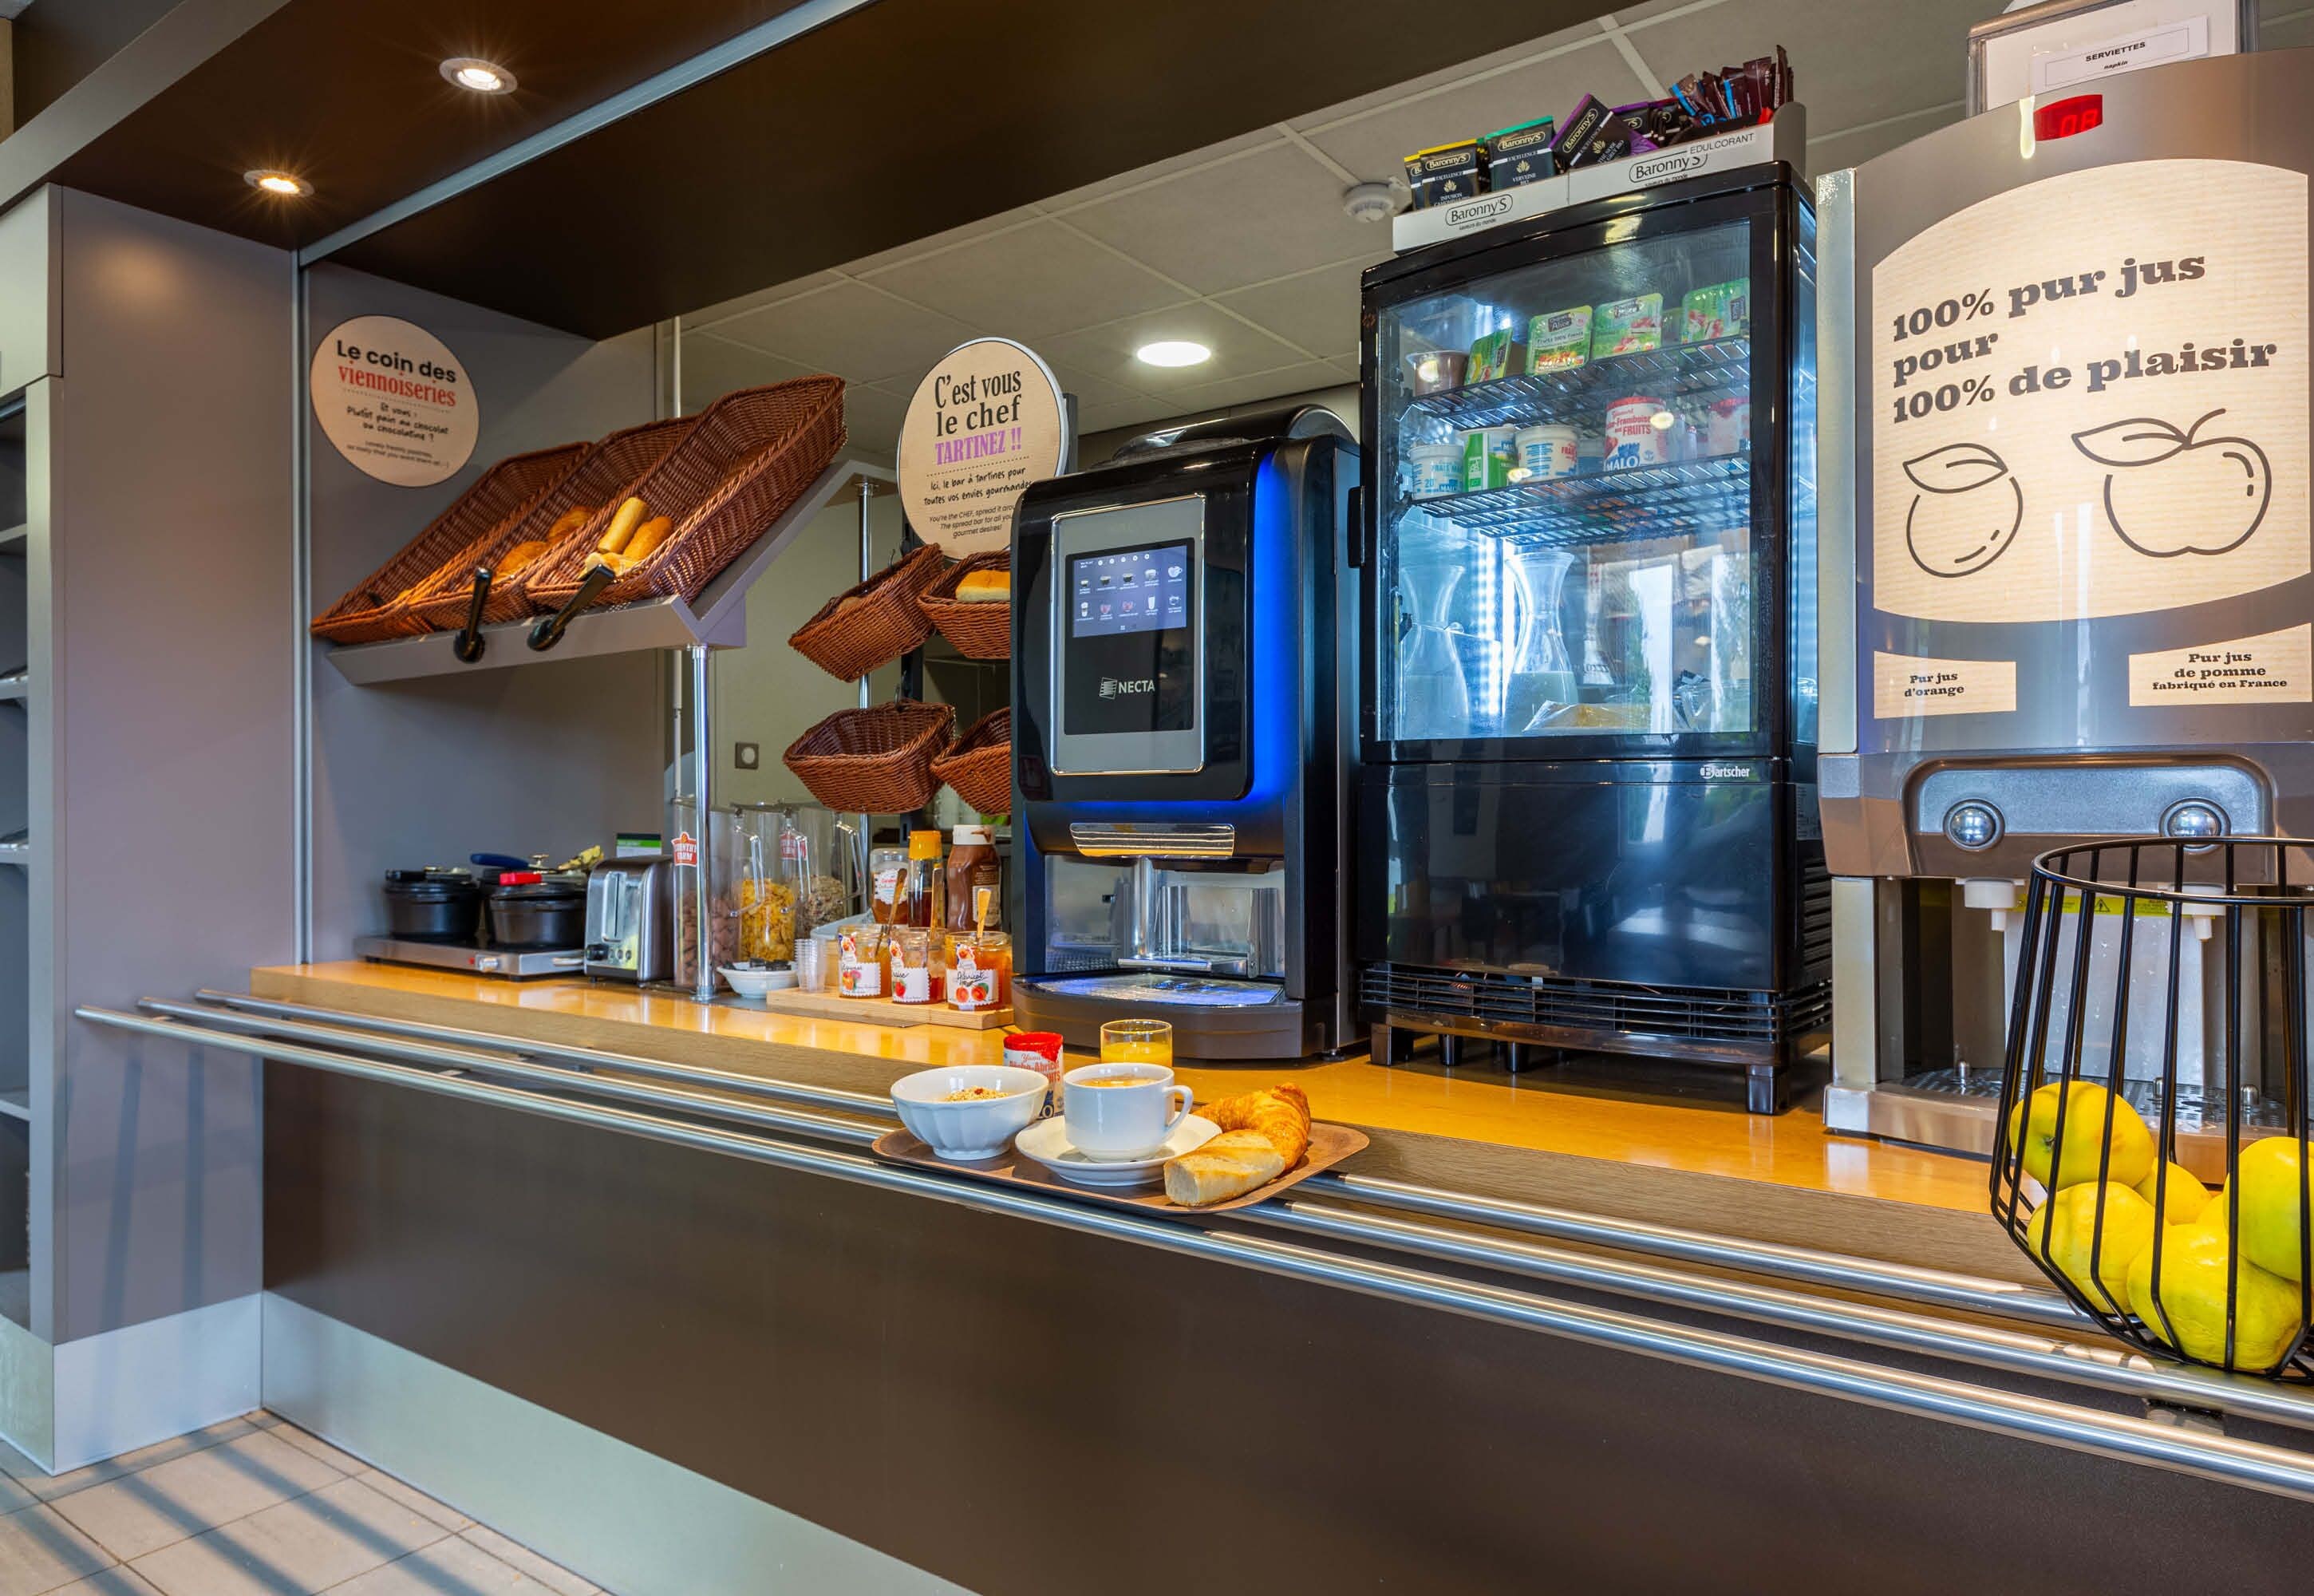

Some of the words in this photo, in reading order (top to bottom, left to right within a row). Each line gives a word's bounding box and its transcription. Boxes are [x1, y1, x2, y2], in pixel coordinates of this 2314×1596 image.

[2085, 41, 2146, 62] SERVIETTES
[2103, 60, 2128, 70] napkin
[1502, 132, 1542, 149] Baronny'S
[1690, 132, 1755, 154] EDULCORANT
[1428, 155, 1467, 169] Baronny'S
[1506, 151, 1538, 162] EXCELLENCE
[1435, 170, 1463, 181] EXCELLENCE
[1451, 197, 1508, 223] Baronny'S
[1893, 288, 1995, 343] 100%
[2008, 270, 2106, 318] pur
[2115, 256, 2205, 298] jus
[337, 339, 361, 359] Le
[366, 352, 413, 373] coin
[419, 361, 457, 383] des
[1893, 332, 1999, 389] pour
[338, 360, 456, 408] viennoiseries
[1893, 375, 1996, 424] 100%
[2008, 365, 2072, 396] de
[2087, 338, 2277, 393] plaisir
[934, 374, 977, 409] C'est
[981, 370, 1022, 398] vous
[936, 412, 958, 437] le
[966, 393, 1022, 431] chef
[413, 421, 449, 435] chocolat
[1622, 425, 1652, 437] FRUITS
[935, 430, 1006, 466] TARTINEZ
[1010, 427, 1022, 451] !!
[943, 479, 950, 489] le
[952, 477, 965, 488] bar
[967, 472, 973, 484] à
[1008, 467, 1027, 479] pour
[948, 493, 960, 503] vos
[962, 489, 984, 500] envies
[975, 507, 997, 516] spread
[952, 520, 973, 530] spread
[1002, 513, 1013, 523] you
[953, 527, 979, 539] gourmet
[2189, 654, 2221, 663] Pur
[2224, 652, 2253, 665] jus
[1909, 675, 1933, 684] Pur
[1936, 673, 1959, 684] jus
[2174, 669, 2197, 678] de
[2200, 668, 2267, 679] pomme
[1119, 680, 1156, 693] NECTA
[1904, 686, 1965, 697] d'orange
[2153, 680, 2216, 691] fabriqué
[1700, 765, 1751, 780] Bartscher
